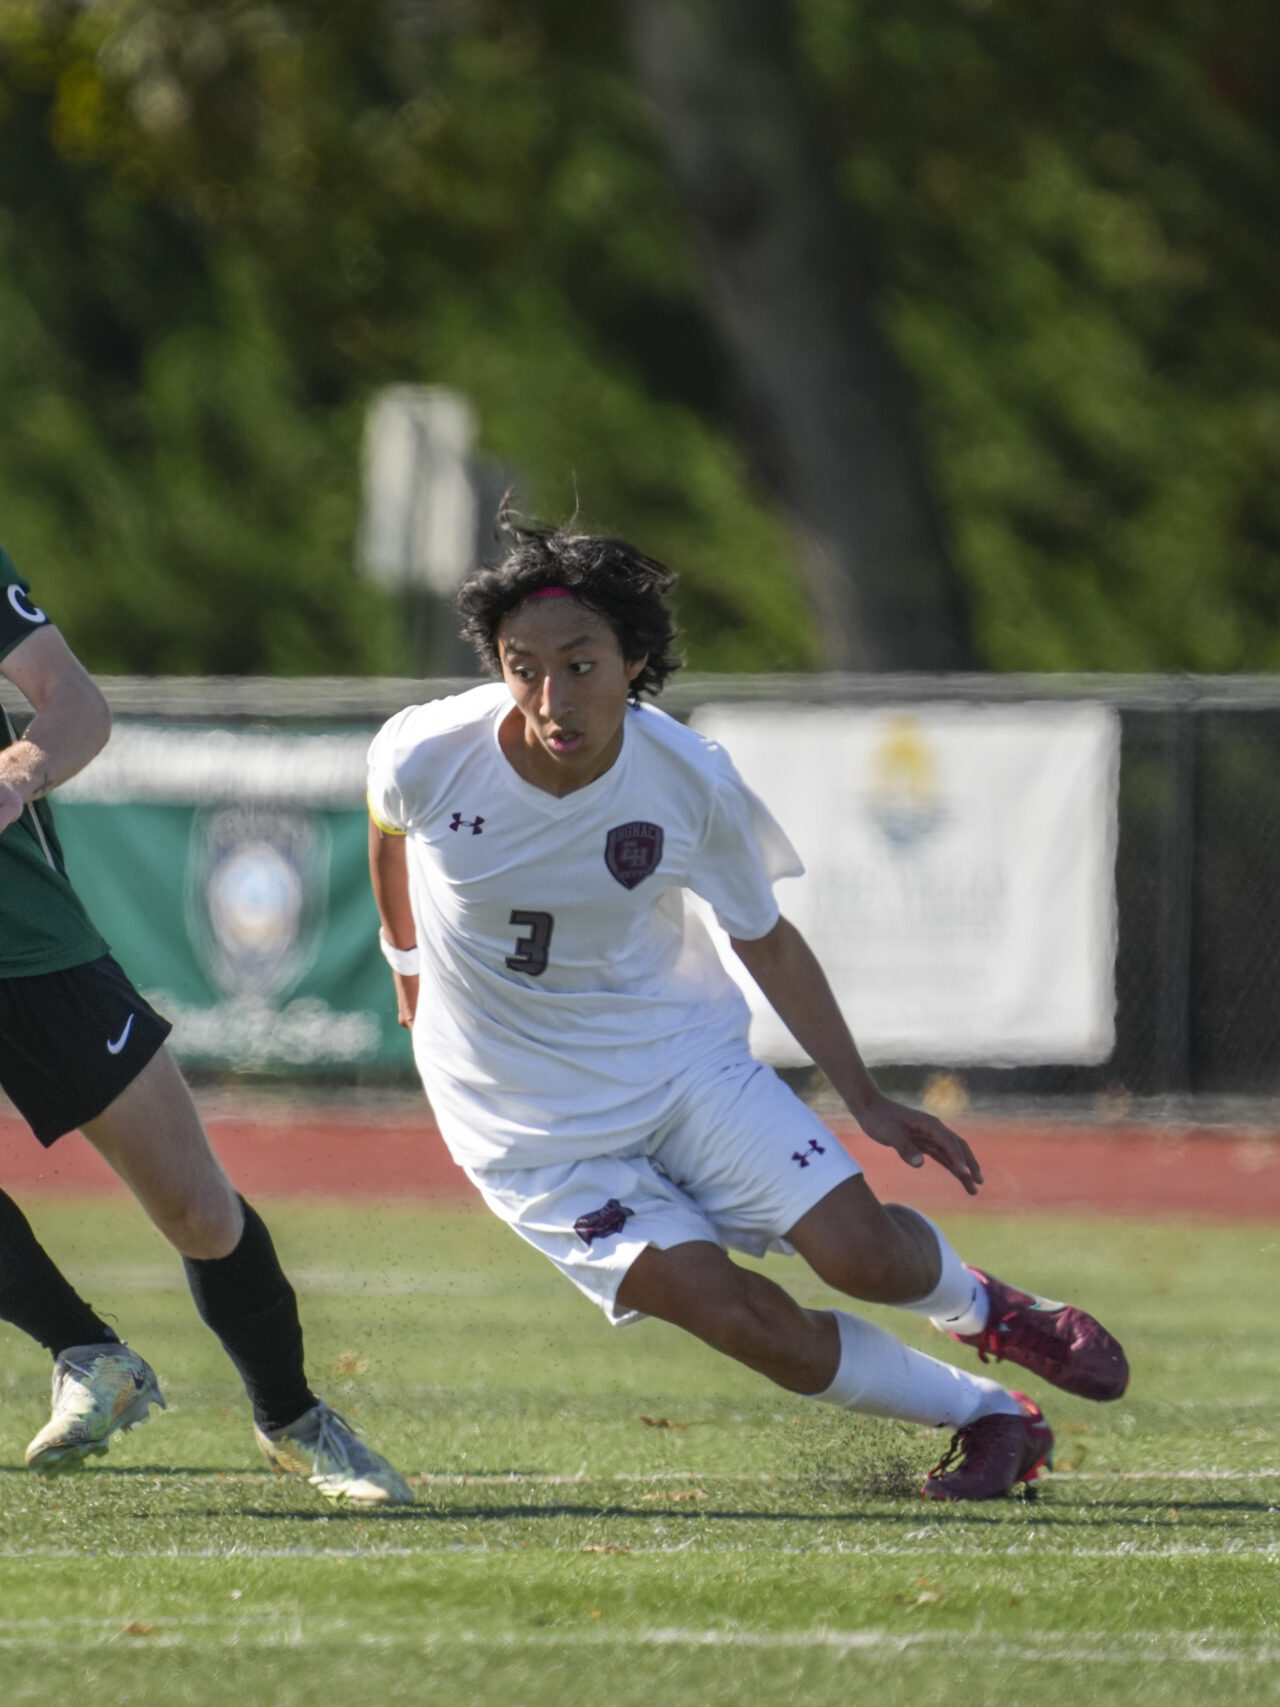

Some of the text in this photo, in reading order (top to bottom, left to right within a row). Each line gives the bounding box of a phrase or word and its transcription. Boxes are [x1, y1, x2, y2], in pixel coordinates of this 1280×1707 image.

[7, 584, 46, 623] C
[617, 823, 656, 841] BONAC
[505, 909, 554, 977] 3
